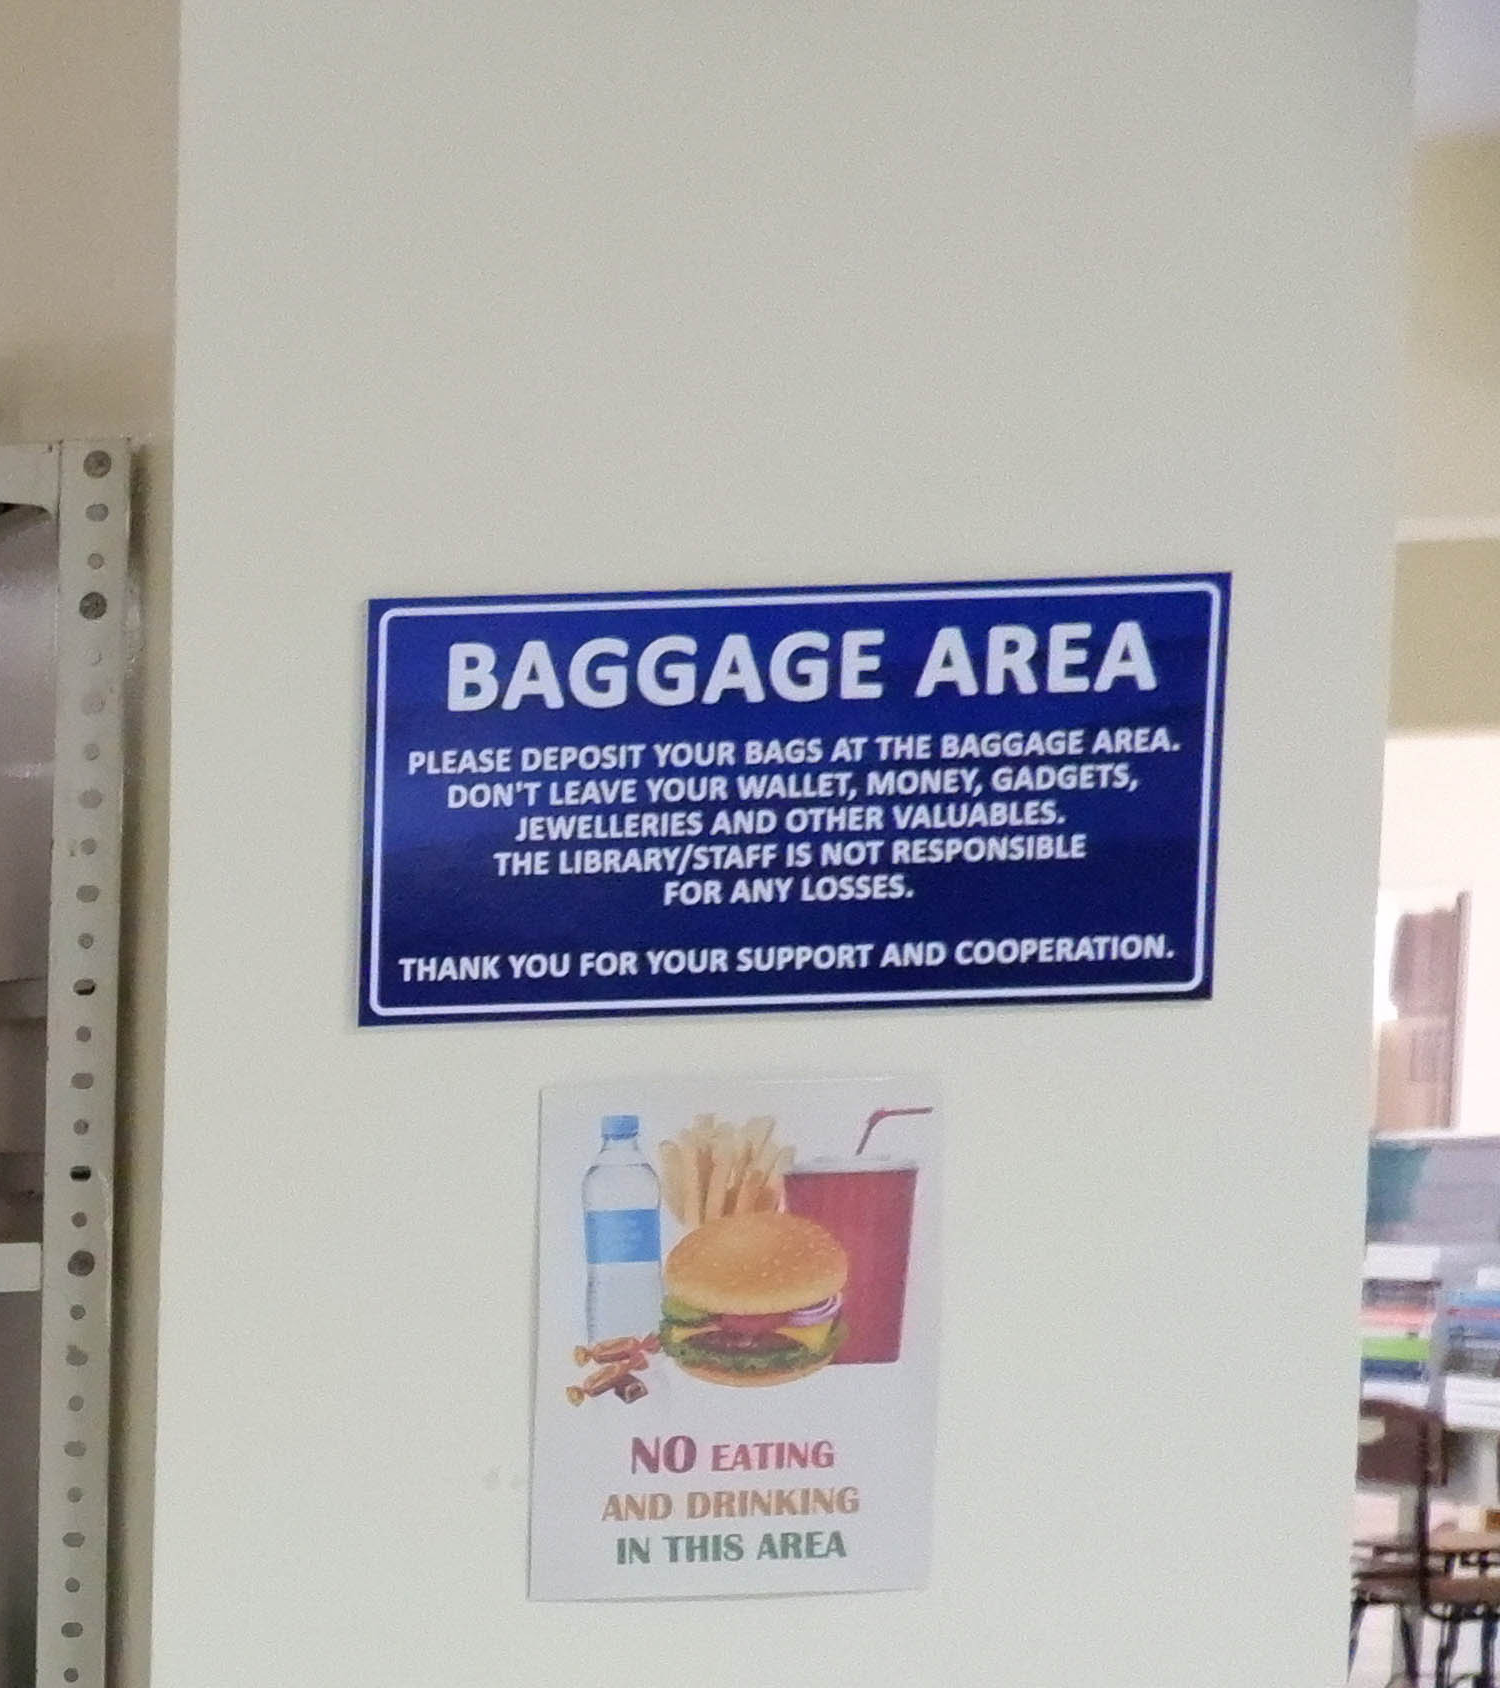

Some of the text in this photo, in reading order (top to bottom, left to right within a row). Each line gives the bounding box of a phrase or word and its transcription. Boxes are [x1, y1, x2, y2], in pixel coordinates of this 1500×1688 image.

[448, 621, 1156, 711] BAGGAGE AREA
[409, 728, 1179, 774] PLEASE DEPOSIT YOUR BAGS AT THE BAGGAGE AREA.
[448, 763, 1137, 808] DON'T LEAVE YOUR WALLET, MONEY, GADGETS,
[516, 800, 1065, 841] JEWELLERIES AND OTHER VALUABLES.
[494, 834, 1086, 876] THE LIBRARY/STAFF IS NOT RESPONSIBLE
[664, 874, 913, 905] FOR ANY LOSSES.
[399, 935, 1174, 981] THANK YOU FOR YOUR SUPPORT AND COOPERATION.
[631, 1435, 836, 1475] NO EATING
[601, 1486, 860, 1522] AND DRINKING
[616, 1531, 847, 1564] IN THIS AREA
